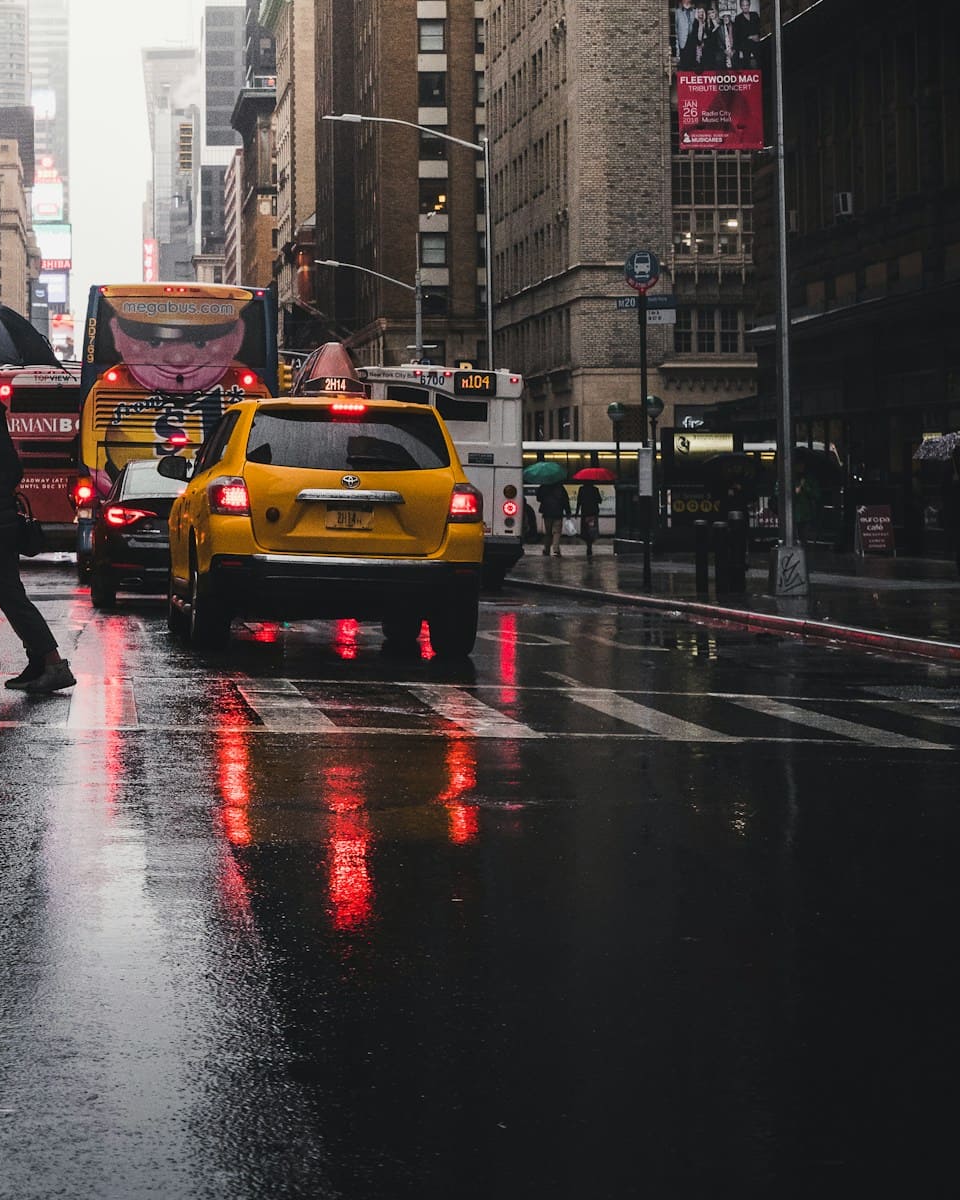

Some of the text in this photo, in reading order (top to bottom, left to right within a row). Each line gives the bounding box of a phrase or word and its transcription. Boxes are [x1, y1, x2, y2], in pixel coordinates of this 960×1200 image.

[680, 74, 759, 85] FLEETWOOD MAC
[718, 84, 751, 92] CONCERT
[682, 100, 698, 108] JAN
[682, 107, 698, 118] 26
[719, 110, 731, 118] City
[618, 297, 636, 308] M20
[123, 301, 235, 316] megabus.com
[87, 318, 97, 363] DD769
[325, 378, 347, 391] 2H14
[420, 375, 445, 386] 6700
